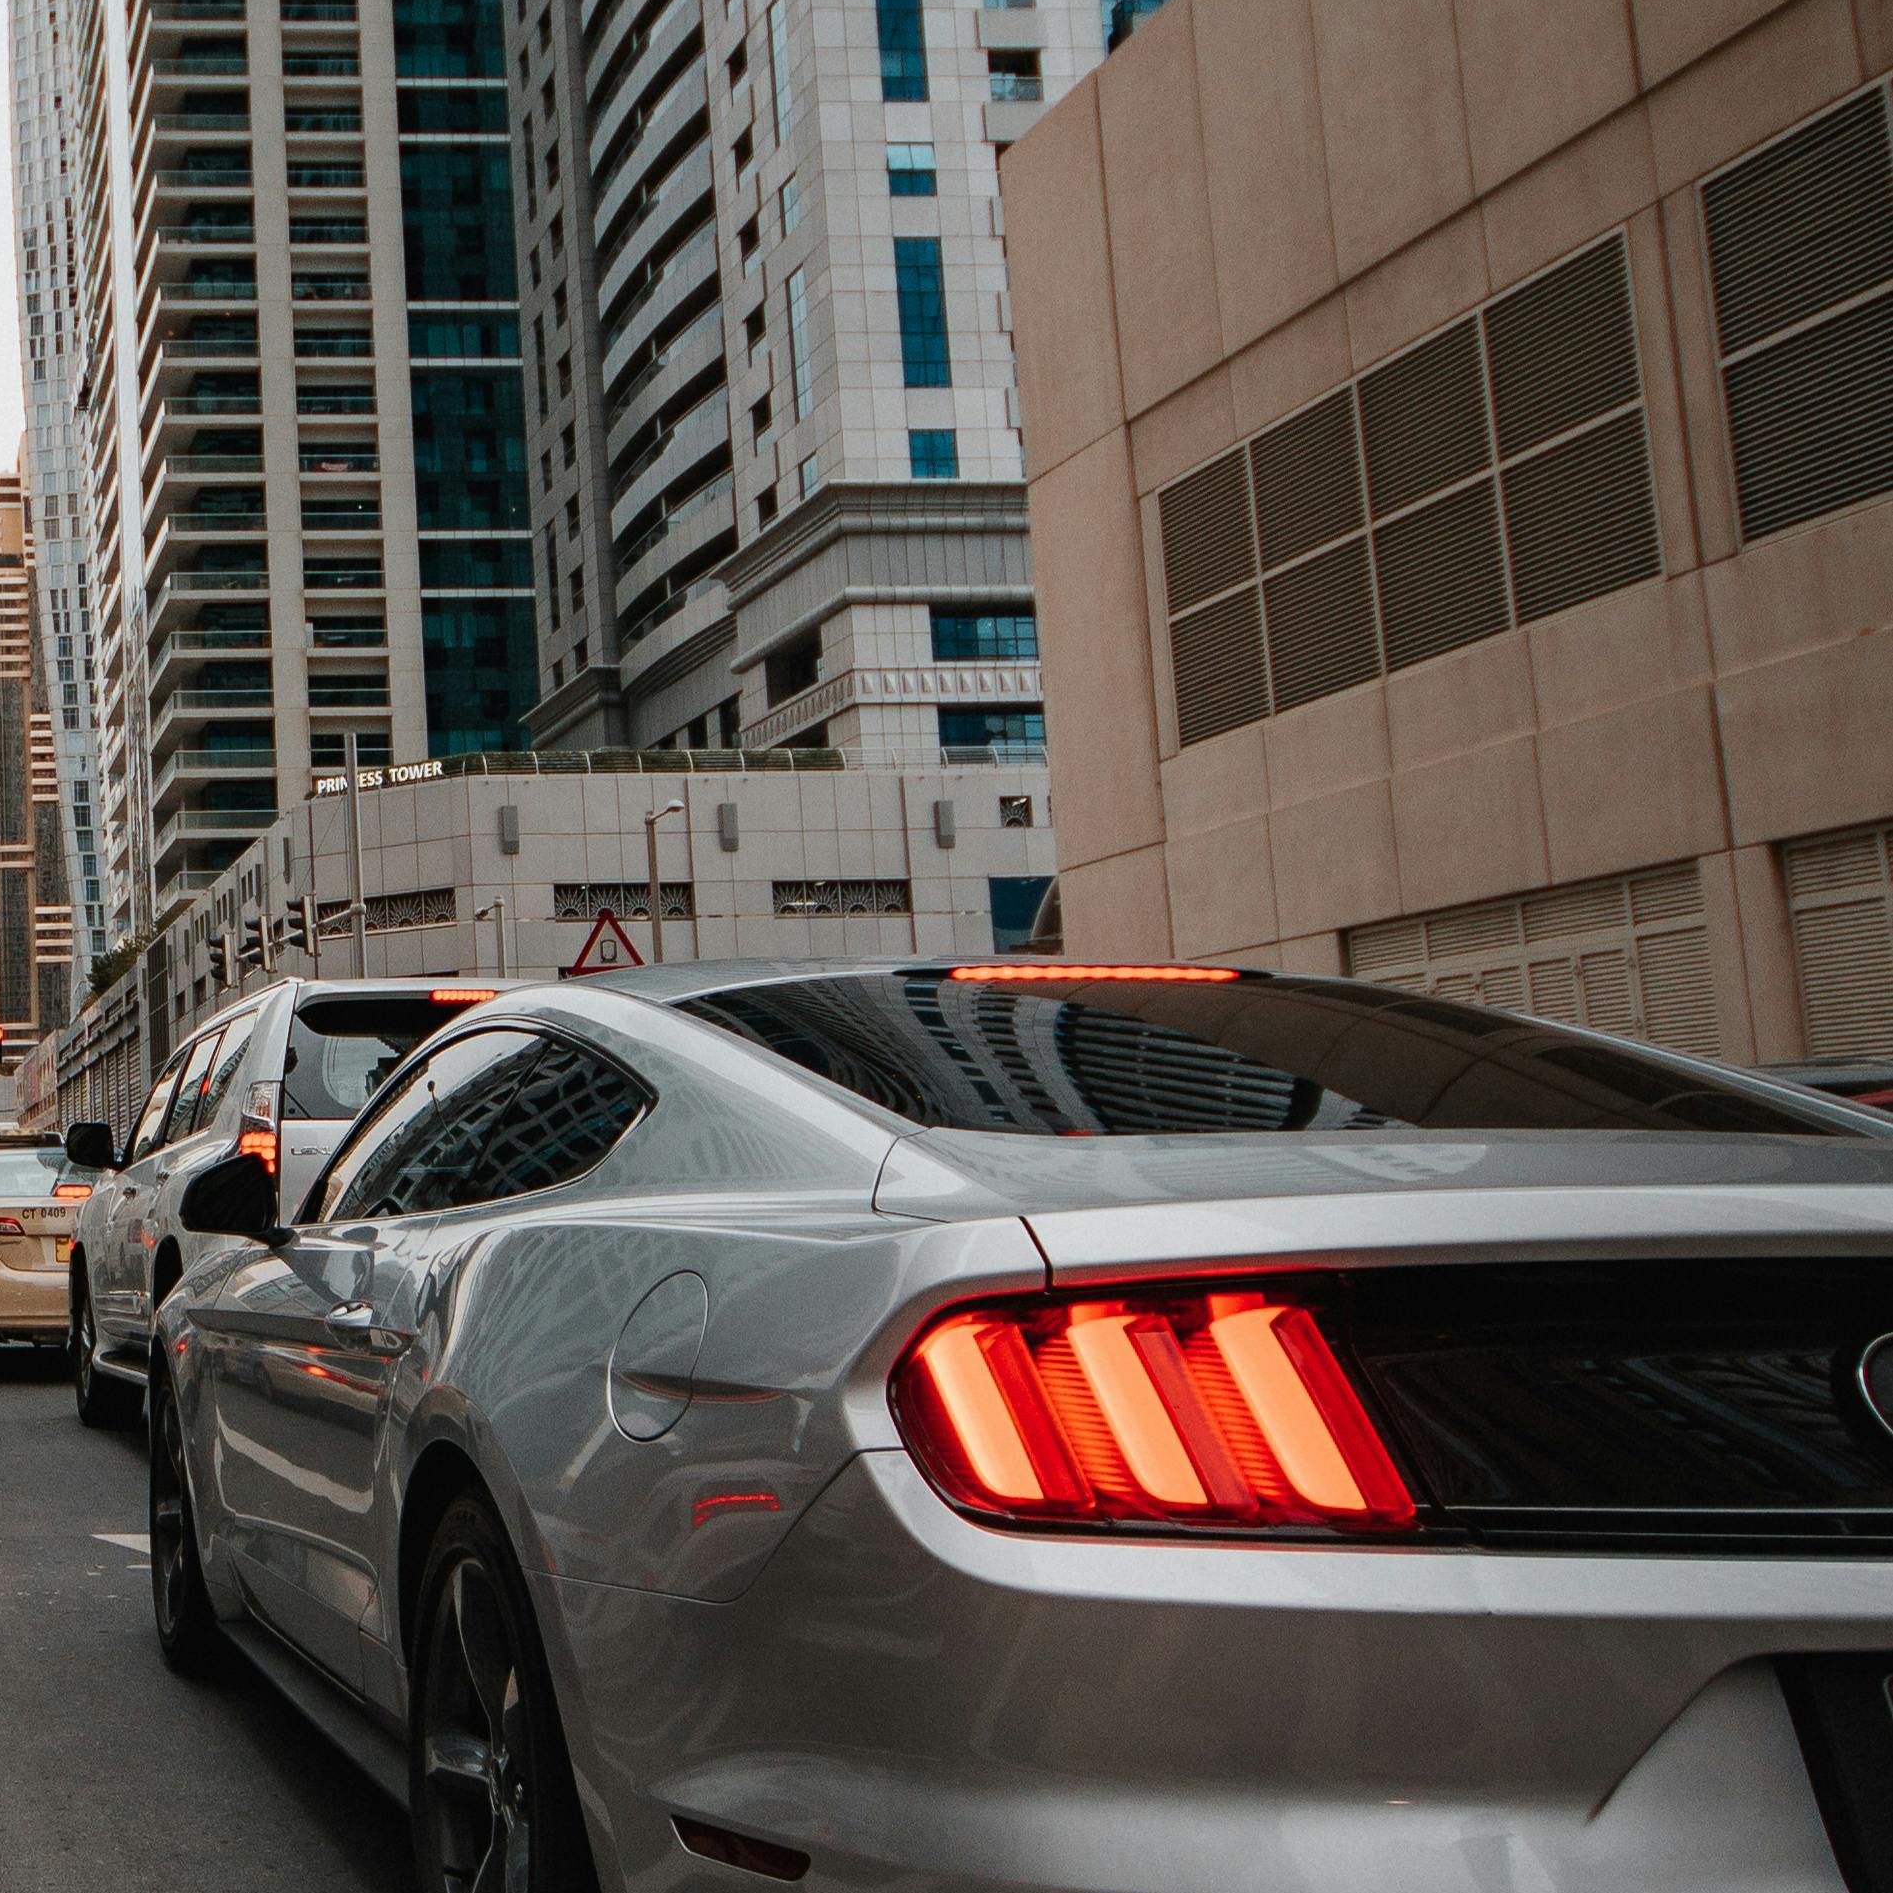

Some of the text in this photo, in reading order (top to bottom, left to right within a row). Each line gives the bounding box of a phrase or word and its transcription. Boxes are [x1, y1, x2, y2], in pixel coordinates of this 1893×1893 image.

[317, 761, 443, 794] PRINESS TOWER
[21, 1207, 66, 1219] CT 0409
